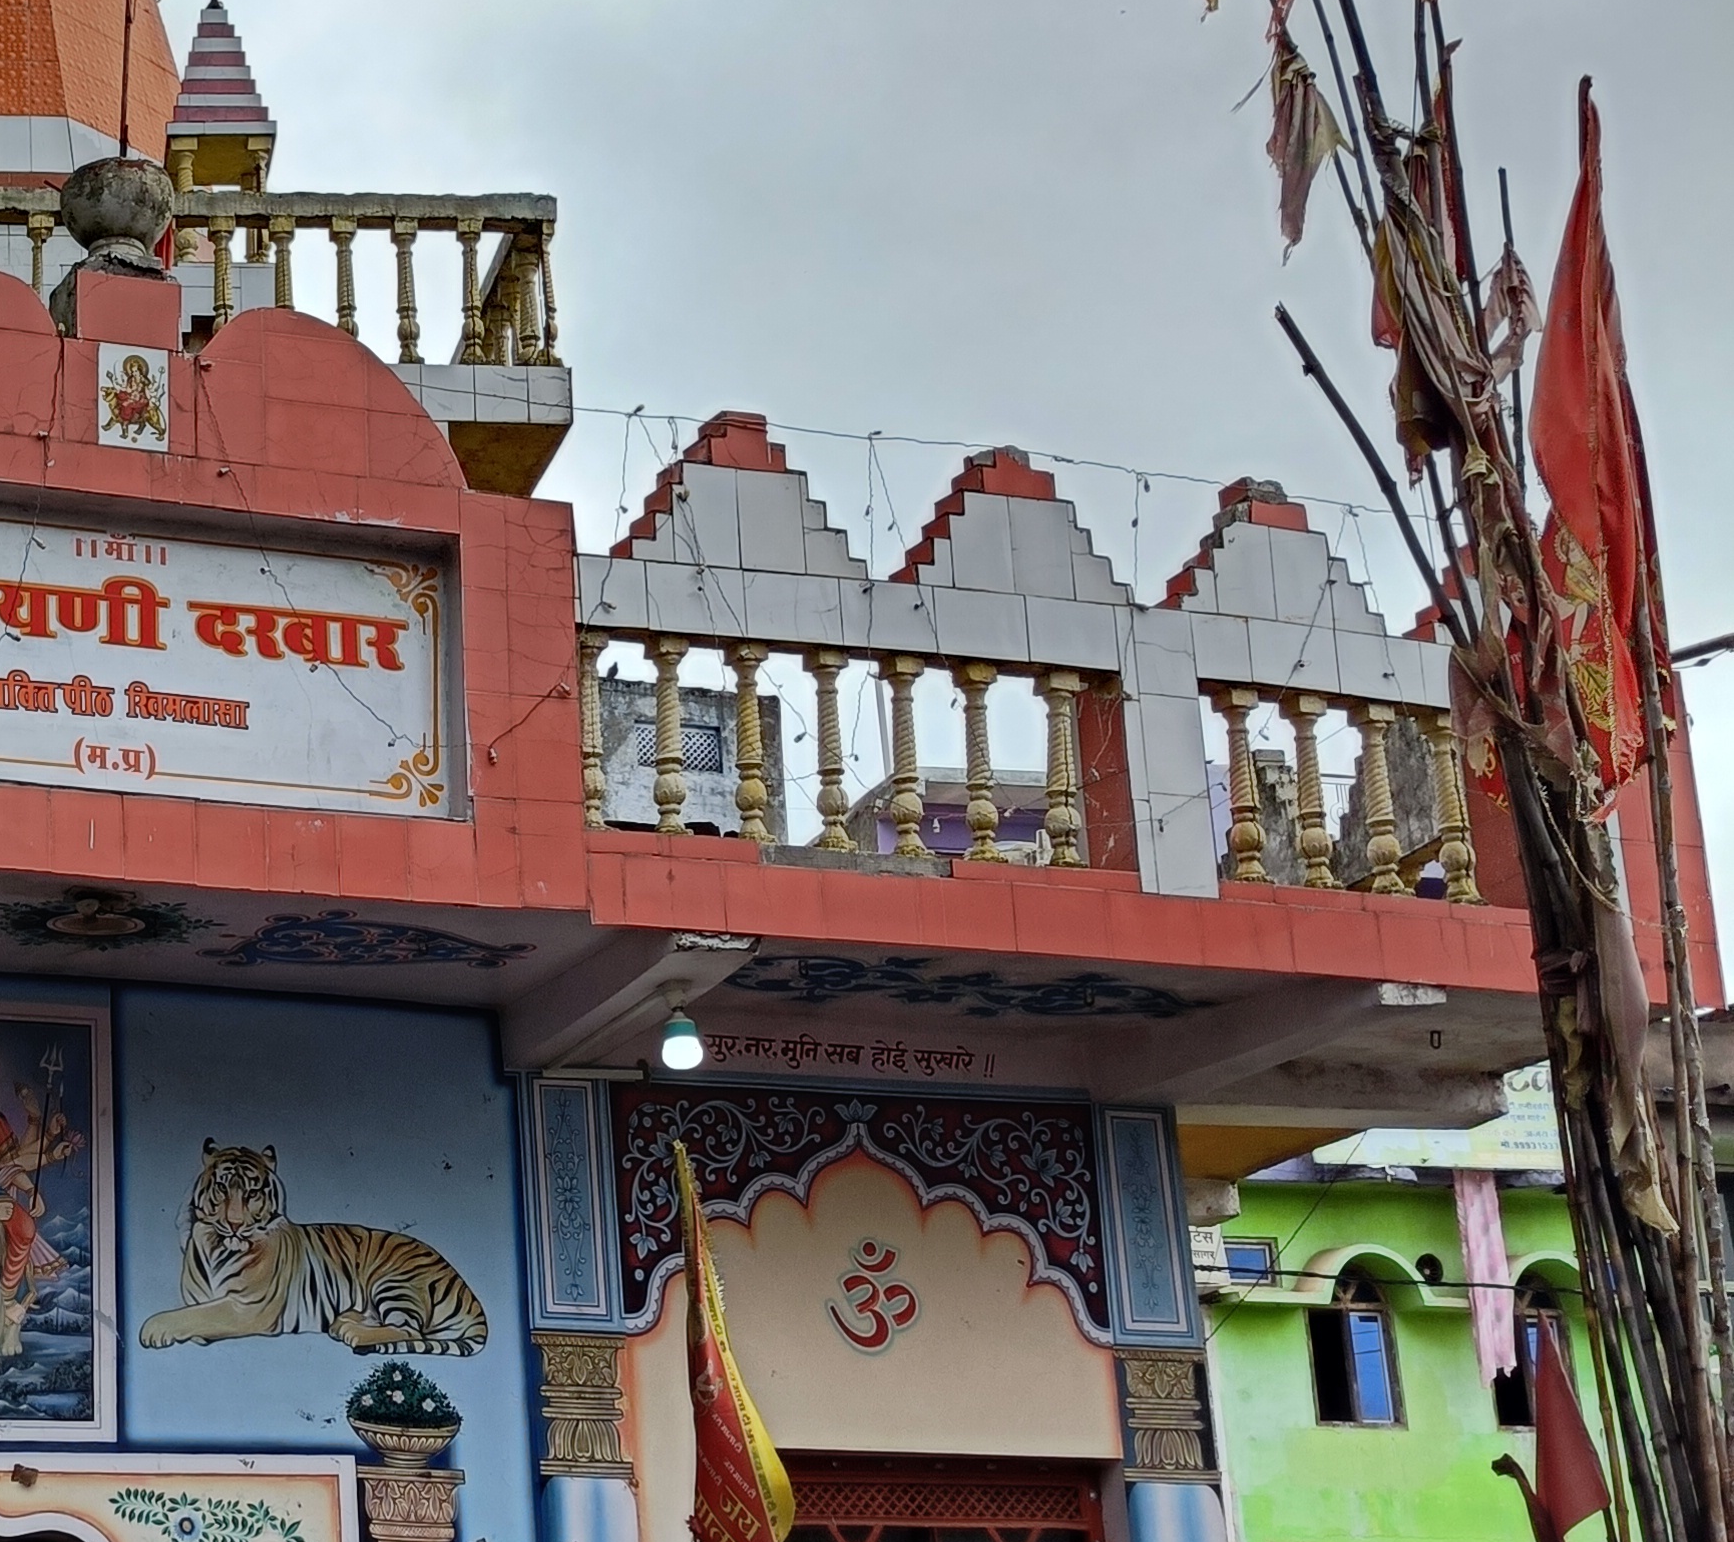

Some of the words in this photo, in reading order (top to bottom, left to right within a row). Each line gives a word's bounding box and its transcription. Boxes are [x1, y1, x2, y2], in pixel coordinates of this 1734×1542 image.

[187, 600, 409, 671] दरबार
[64, 675, 115, 718] पीठ
[126, 681, 250, 730] खिमलासा
[824, 1043, 865, 1065] सब
[870, 1040, 908, 1073] होई
[914, 1045, 975, 1076] सुखारे
